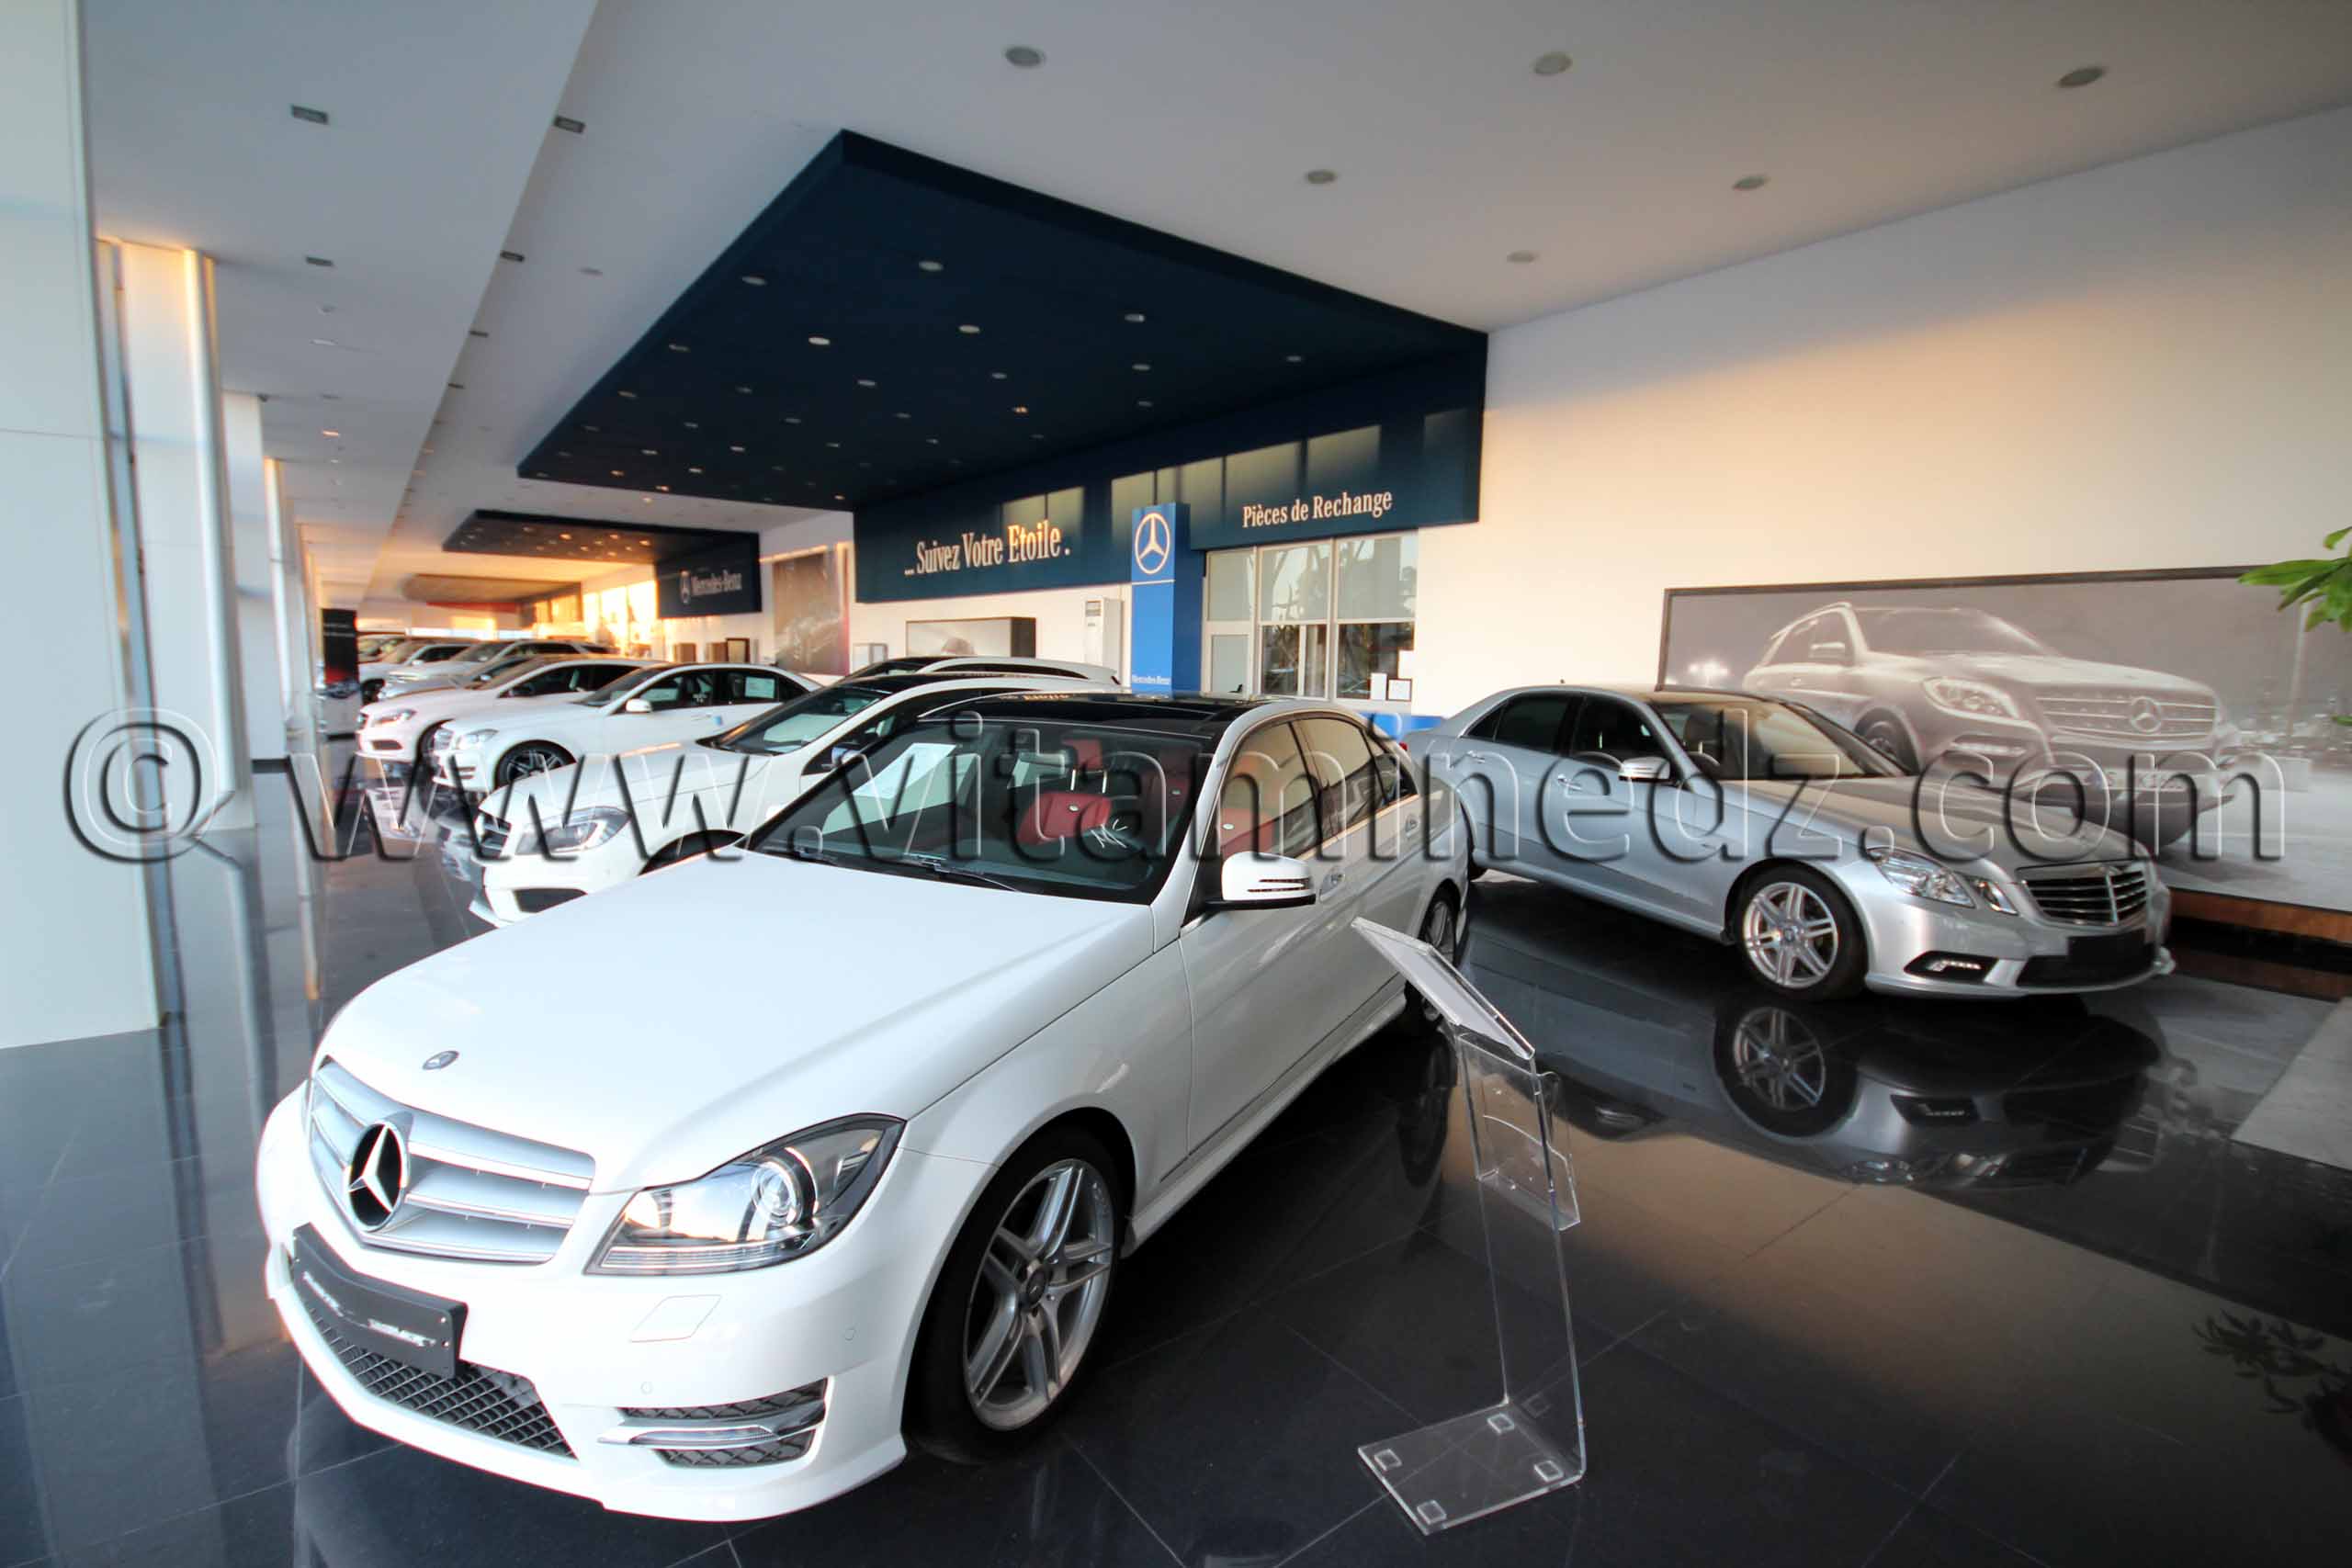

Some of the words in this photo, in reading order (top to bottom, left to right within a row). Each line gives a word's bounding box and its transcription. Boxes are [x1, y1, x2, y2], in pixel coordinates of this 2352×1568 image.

[1242, 504, 1287, 528] Pièces
[1291, 499, 1308, 522] de
[1313, 491, 1393, 519] Rechange
[962, 531, 1003, 569] Votre
